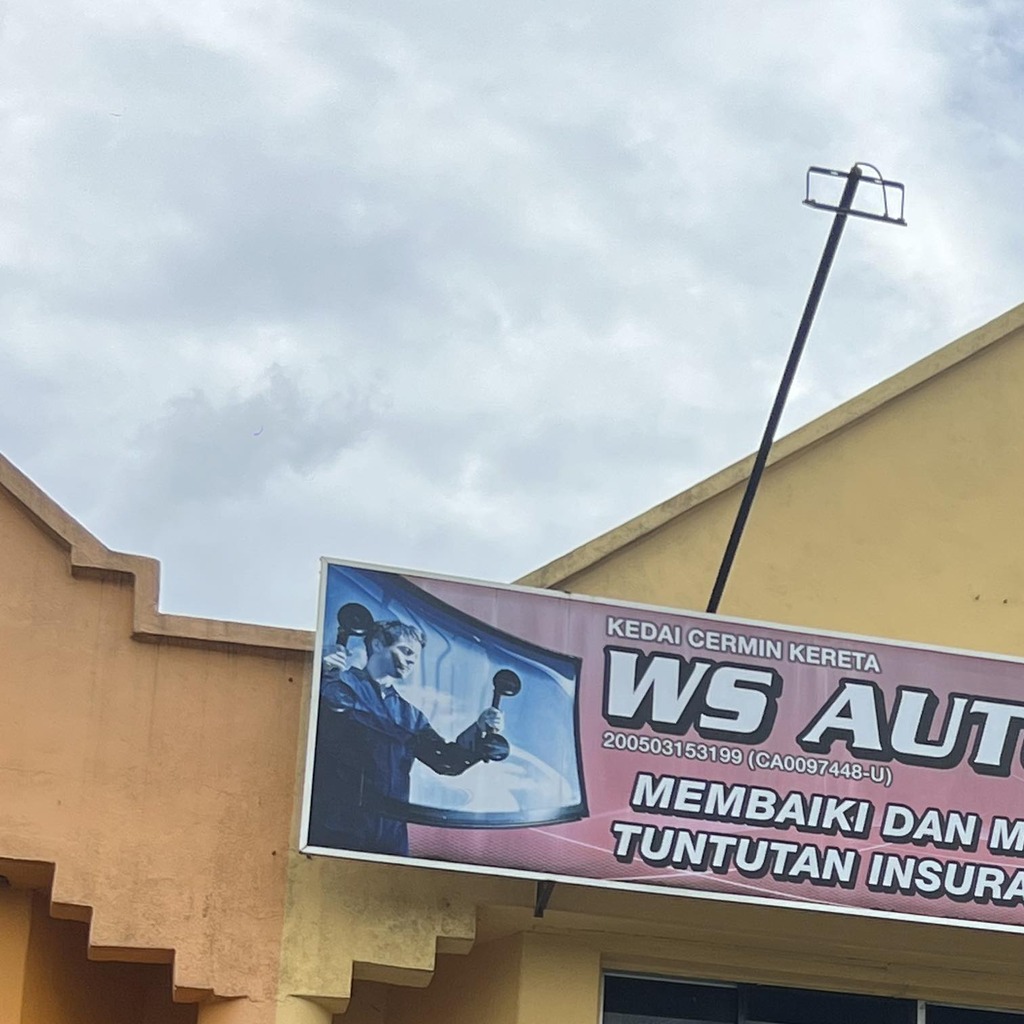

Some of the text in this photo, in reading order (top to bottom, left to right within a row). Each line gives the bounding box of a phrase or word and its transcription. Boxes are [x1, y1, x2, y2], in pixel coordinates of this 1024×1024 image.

[607, 617, 880, 673] KEDAI CERMIN KERETA
[604, 648, 780, 742] WS
[602, 731, 892, 786] 200503153199 (CA0097448-U)
[632, 774, 873, 836] MEMBAIKI
[880, 804, 980, 848] DAN
[610, 822, 860, 886] TUNTUTAN
